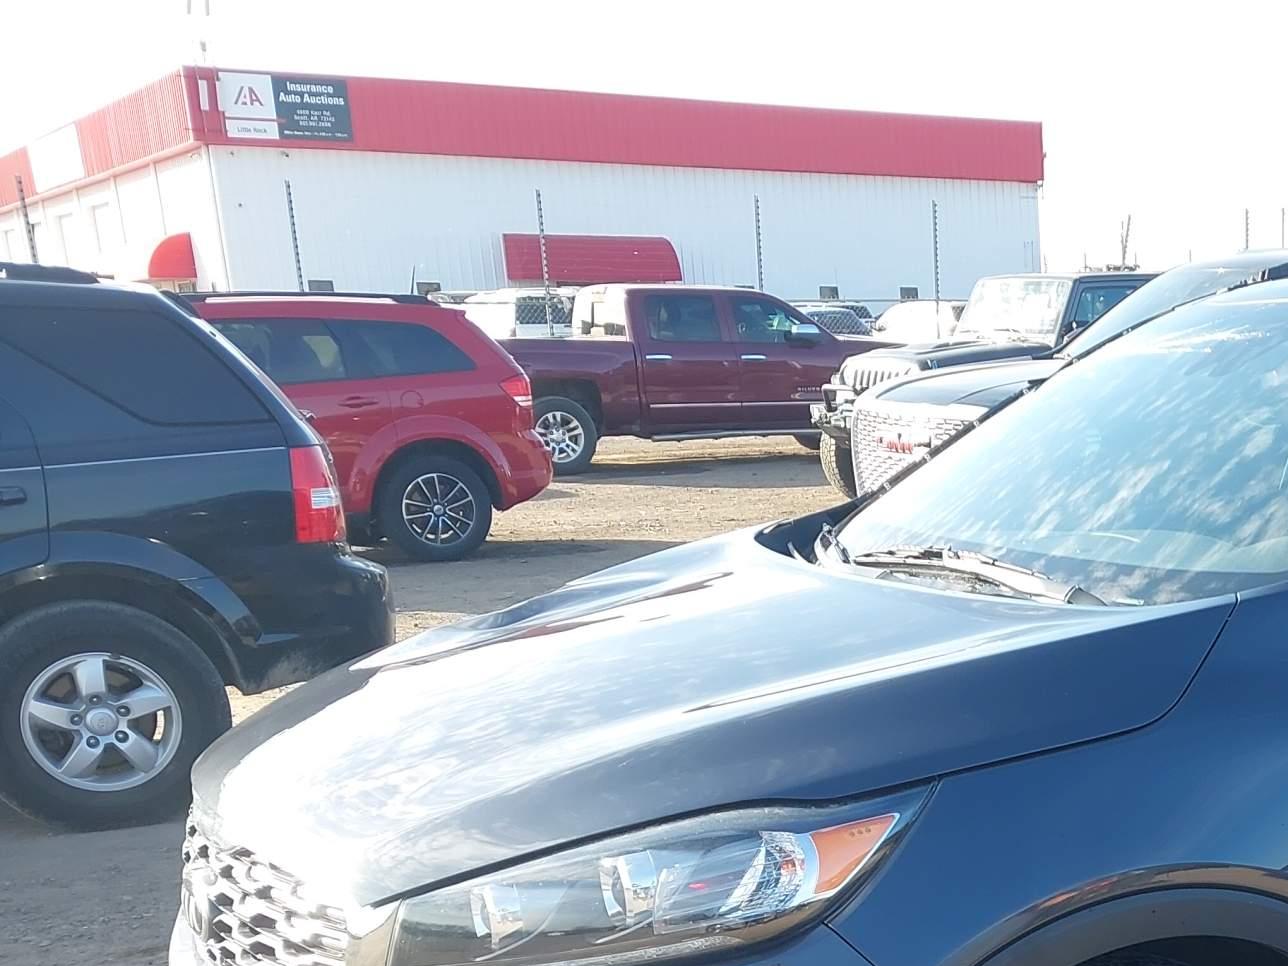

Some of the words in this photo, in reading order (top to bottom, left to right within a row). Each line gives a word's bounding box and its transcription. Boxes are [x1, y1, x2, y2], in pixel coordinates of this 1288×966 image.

[286, 81, 333, 94] Insurance
[279, 92, 301, 104] Auto
[303, 94, 345, 105] Auctions
